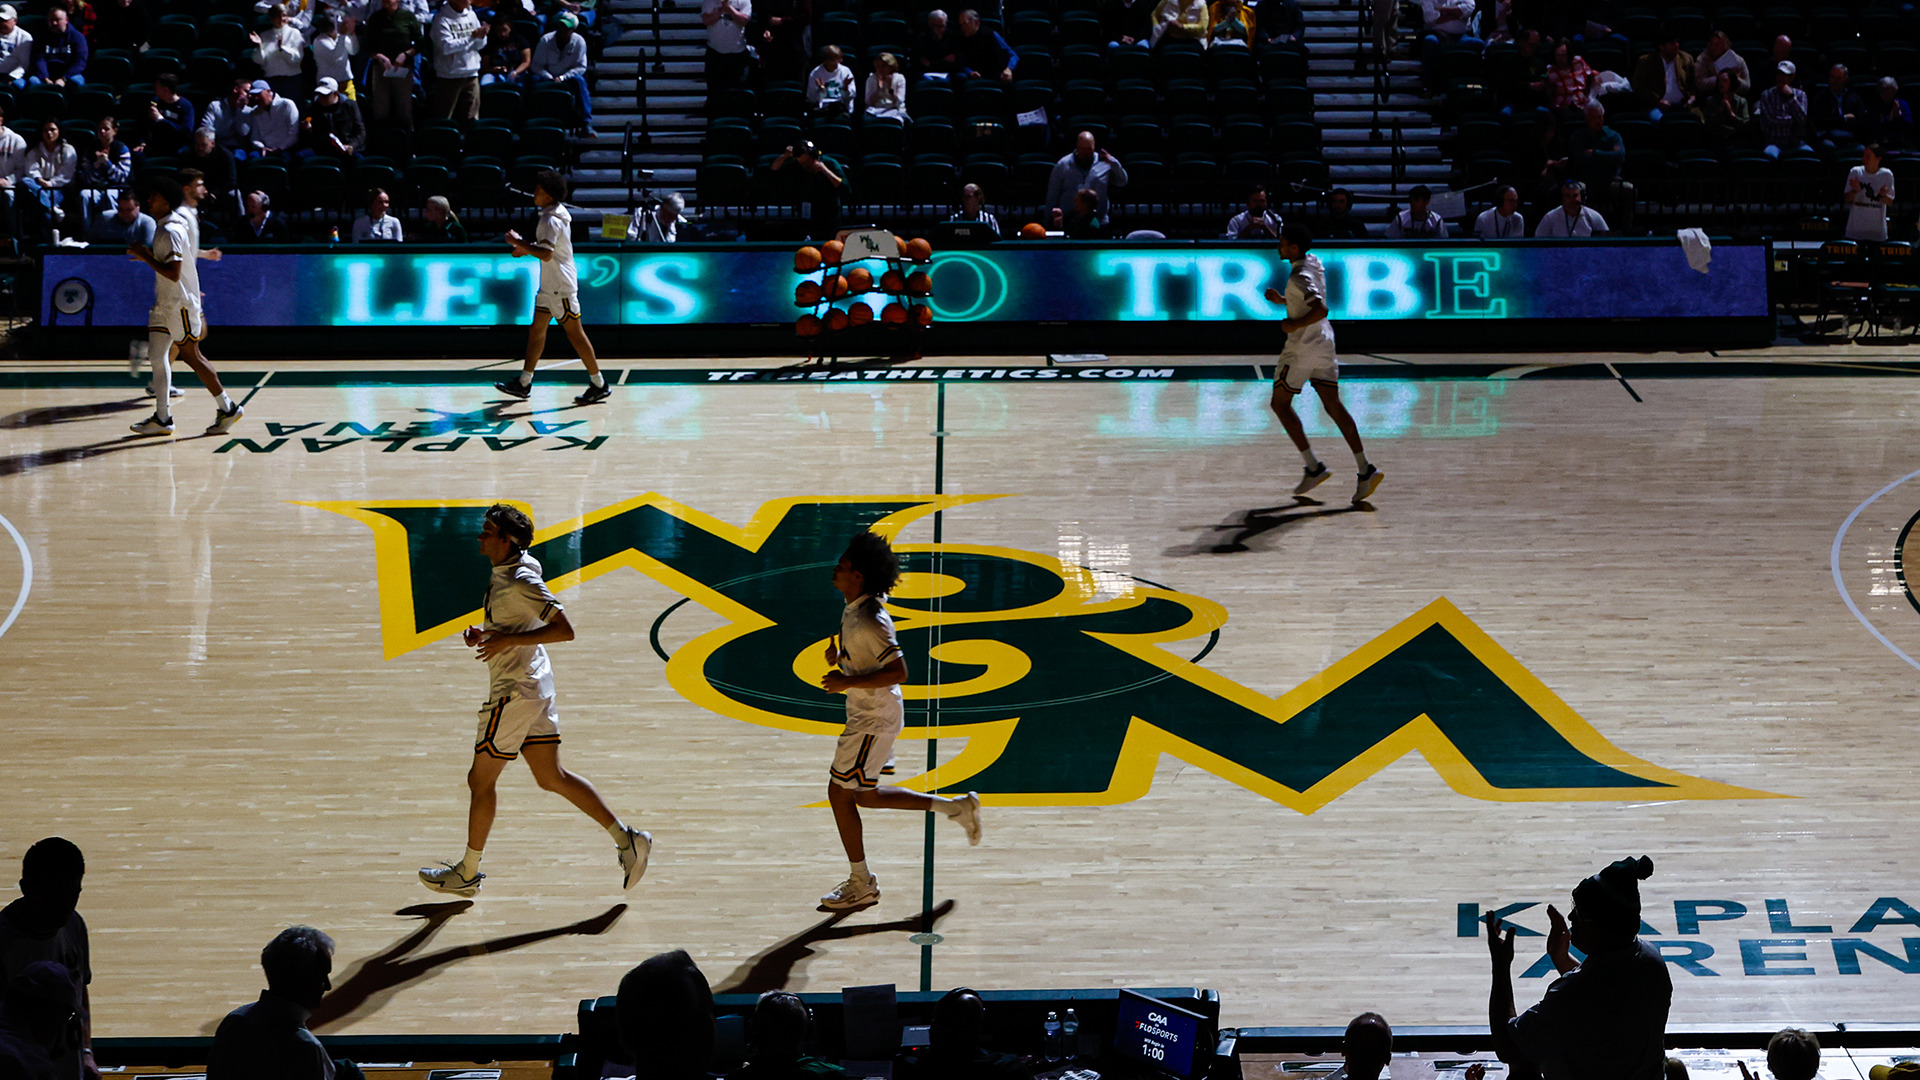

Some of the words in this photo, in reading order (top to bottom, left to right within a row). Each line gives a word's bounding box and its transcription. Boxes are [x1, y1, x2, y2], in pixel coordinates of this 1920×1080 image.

[1097, 250, 1508, 319] TRBE
[213, 435, 609, 453] KAPLAN
[1457, 897, 1920, 938] KPLA
[1148, 1012, 1168, 1026] CAA
[1139, 1022, 1179, 1042] FLOSPORTS
[1142, 1044, 1164, 1061] 1:00
